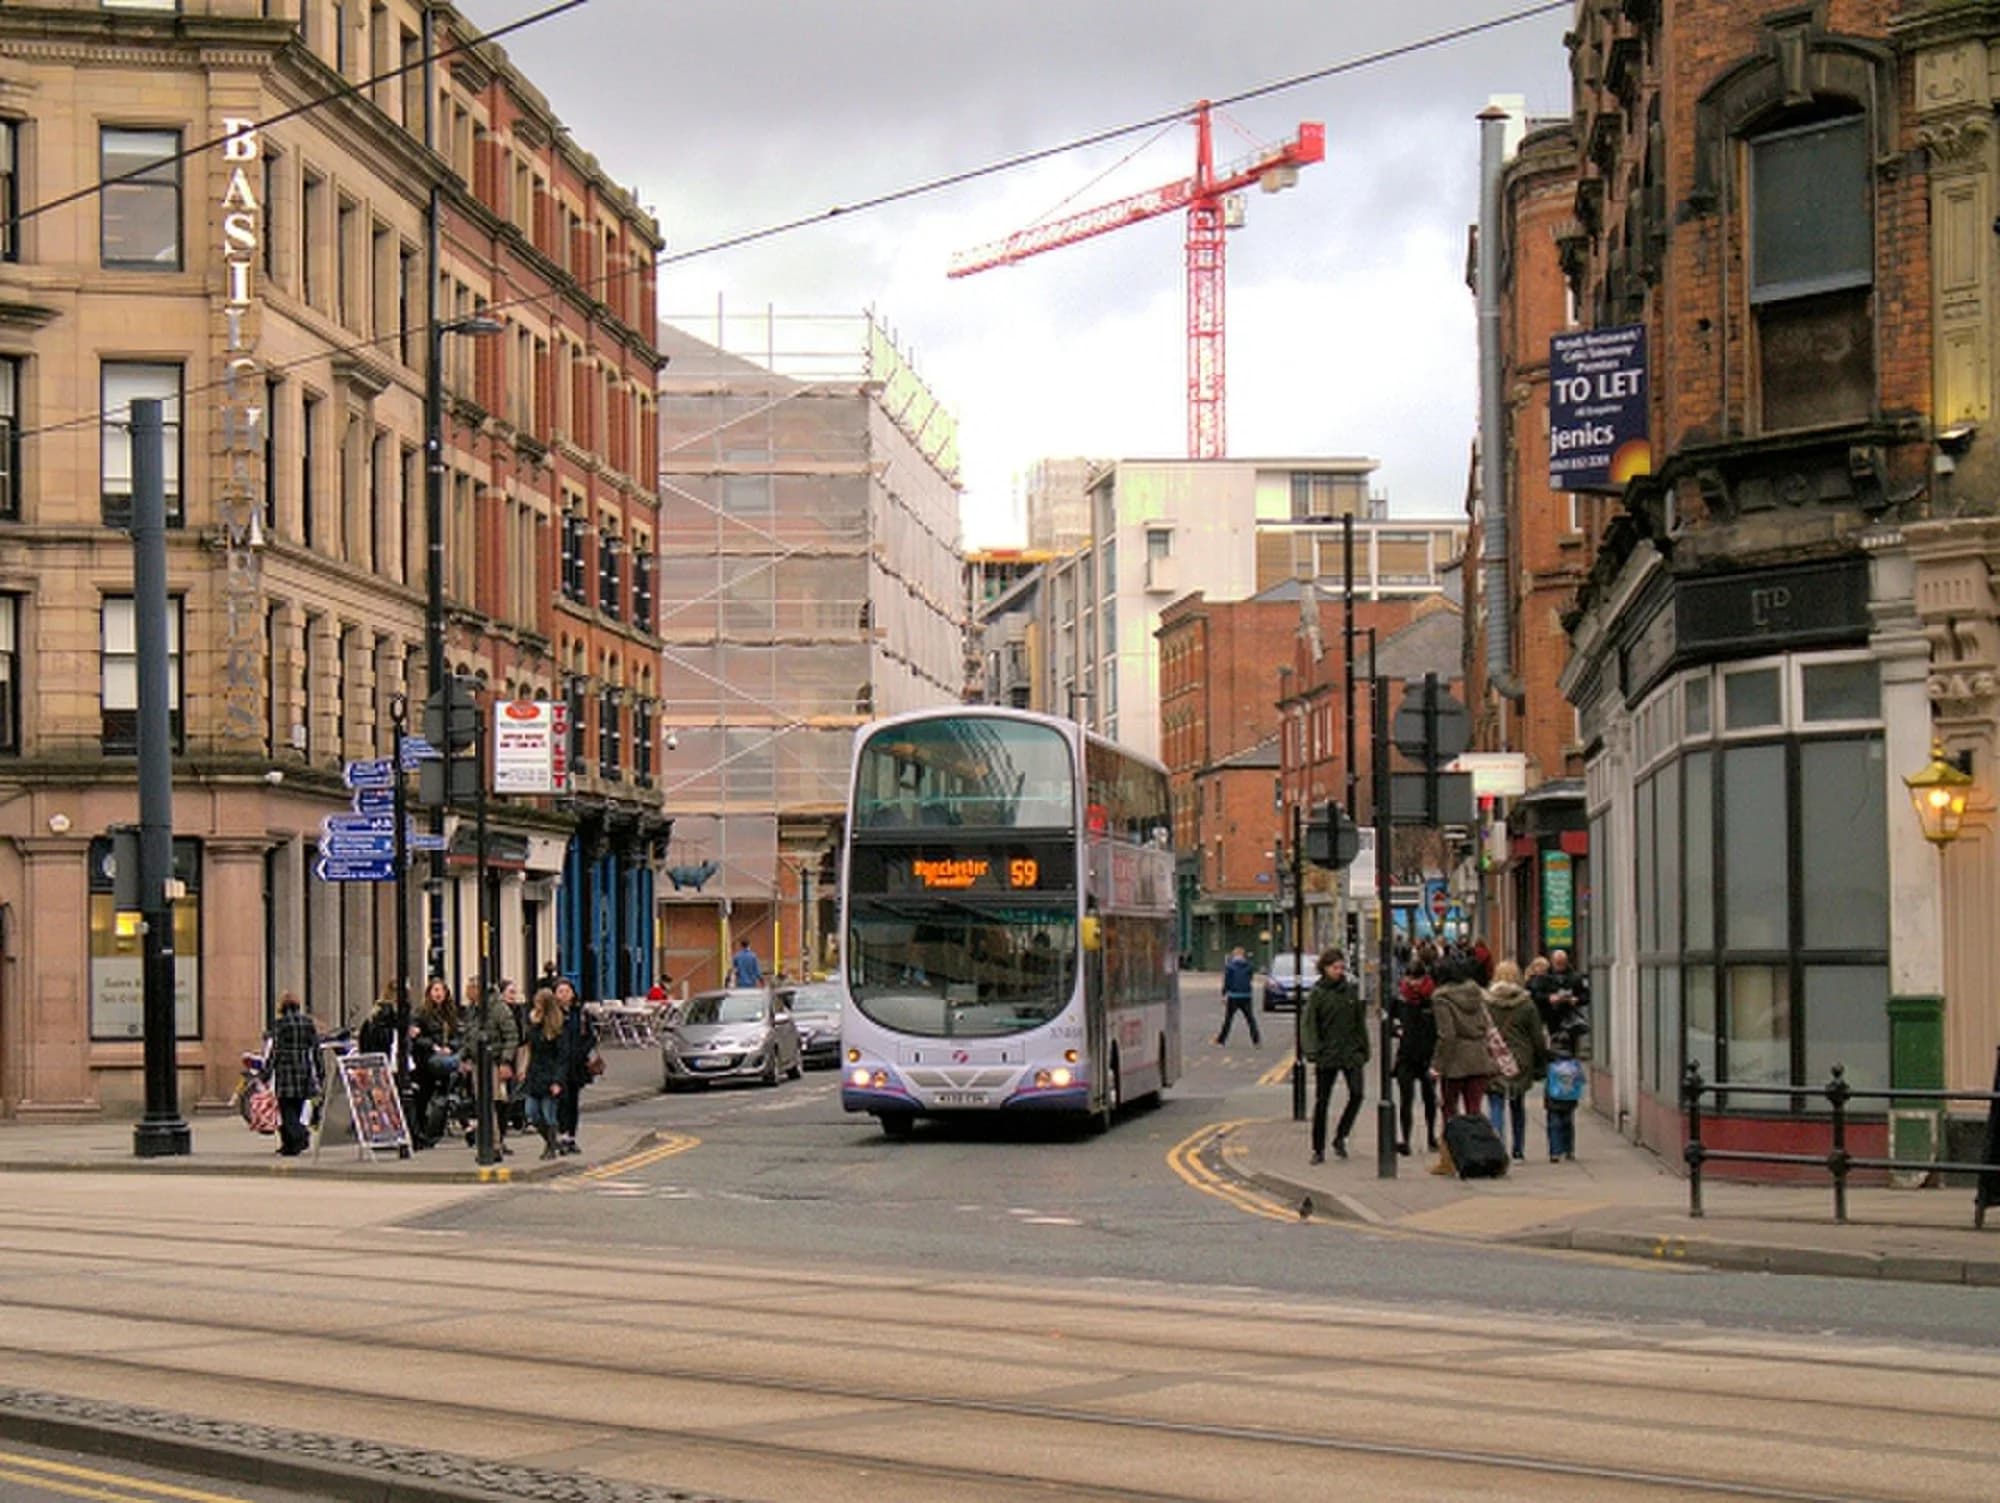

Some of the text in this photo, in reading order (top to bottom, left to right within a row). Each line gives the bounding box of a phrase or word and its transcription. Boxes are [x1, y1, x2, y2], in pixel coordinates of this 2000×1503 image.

[222, 117, 258, 351] BASIL
[1554, 369, 1643, 405] TO LET
[1550, 421, 1615, 456] jenics
[1011, 859, 1039, 888] 59
